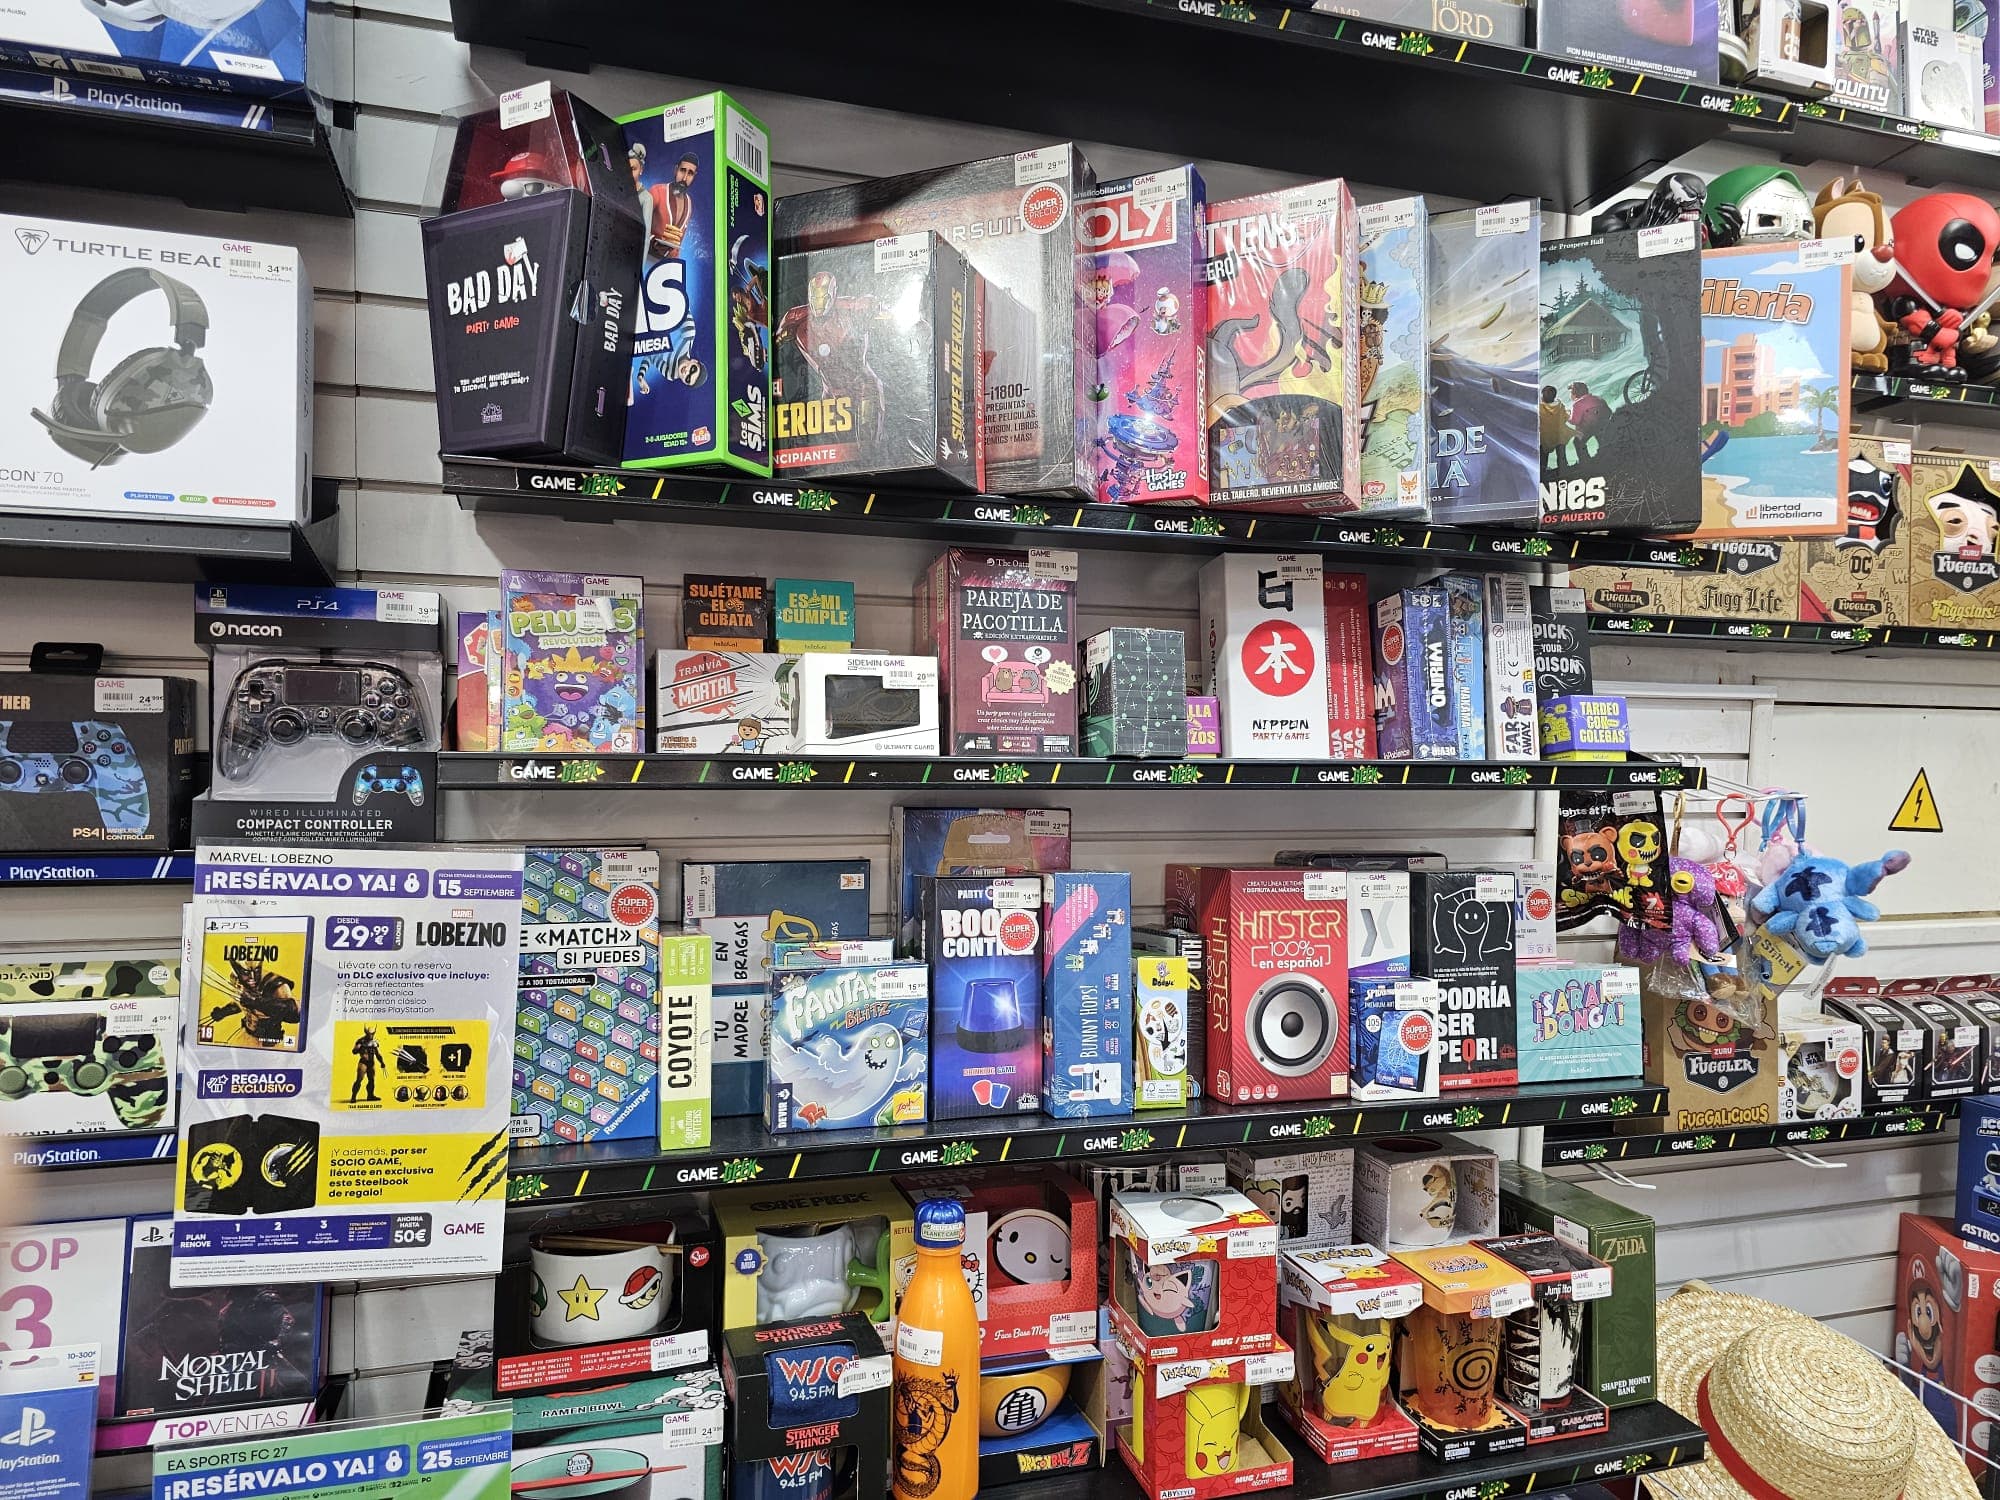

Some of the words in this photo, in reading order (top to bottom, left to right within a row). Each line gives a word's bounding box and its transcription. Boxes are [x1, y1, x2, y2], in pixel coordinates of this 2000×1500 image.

[1912, 27, 1937, 39] STAR
[1361, 32, 1397, 50] GAME
[1913, 35, 1939, 47] WARS
[1548, 67, 1579, 84] GAME
[87, 87, 182, 114] PlayStation
[1701, 95, 1731, 111] GAME
[1029, 197, 1057, 211] SÚPER
[1029, 205, 1059, 218] PRECIO
[53, 238, 152, 261] TURTLE
[222, 243, 252, 253] GAME
[447, 271, 491, 316] BAD
[498, 263, 540, 302] DAY
[608, 287, 624, 315] DAY
[466, 320, 490, 334] PARTY
[603, 316, 618, 353] BAD
[634, 337, 670, 354] MESA
[1436, 425, 1487, 458] DE
[44, 471, 63, 484] 70
[1146, 468, 1187, 482] Hasbro
[531, 476, 576, 491] GAME
[1148, 479, 1185, 491] GAMES
[1222, 490, 1229, 500] EL
[1262, 485, 1291, 497] REVIENTA
[1293, 485, 1298, 494] A
[1300, 483, 1311, 494] TUS
[1313, 480, 1340, 492] AMIGOS.
[1759, 503, 1800, 512] libertad
[1562, 511, 1605, 521] MUERTO
[1759, 511, 1822, 520] inmobiliaria
[1154, 520, 1188, 532] GAME
[1492, 541, 1521, 552] GAME
[1937, 555, 1997, 577] FUGGLER
[689, 583, 762, 599] SUJÉTAME
[297, 599, 338, 611] PS4
[712, 600, 725, 611] EL
[966, 589, 1033, 613] PAREJA
[1036, 593, 1063, 610] DE
[699, 613, 753, 627] CUBATA
[782, 607, 848, 625] CUMPLE
[962, 613, 1066, 633] PACOTILLA
[228, 622, 282, 637] nacon
[541, 636, 603, 646] REVOLUTION
[848, 659, 881, 667] SIDEWIN
[1254, 631, 1306, 683] 本
[678, 659, 722, 677] TRANVÍA
[96, 680, 125, 689] GAME
[678, 682, 734, 706] MORTAL
[1579, 701, 1619, 715] TARDEO
[1252, 719, 1309, 730] NIPPON
[1252, 731, 1283, 740] PARTY
[1285, 732, 1310, 740] GAME
[1504, 721, 1520, 754] FAR
[1523, 722, 1533, 755] AWAY
[1579, 730, 1625, 743] COLEGAS
[510, 766, 555, 779] GAME
[953, 768, 990, 781] GAME
[1317, 770, 1350, 782] GAME
[249, 809, 279, 817] WIRED
[287, 809, 381, 817] ILLUMINATED
[236, 818, 301, 829] COMPACT
[305, 819, 393, 830] CONTROLLER
[73, 827, 99, 838] PS4
[209, 851, 268, 864] MARVEL:
[271, 853, 333, 865] LOBEZNO
[204, 868, 353, 893] ¡RESÉRVALO
[359, 874, 396, 892] YA!
[439, 879, 461, 896] 15
[464, 888, 515, 897] SEPTIEMBRE
[617, 897, 648, 908] SÚPER
[452, 909, 473, 918] MARVEL
[616, 905, 648, 915] PRECIO
[1240, 910, 1341, 940] HITSTER
[416, 922, 506, 947] LOBEZNO
[535, 927, 632, 947] «MATCH»
[223, 945, 279, 962] LOBEZNO
[734, 921, 749, 980] BRAGAS
[1269, 942, 1315, 957] 100%
[563, 952, 577, 965] SI
[583, 950, 640, 964] PUEDES
[1259, 960, 1274, 969] en
[1276, 957, 1324, 971] español
[338, 961, 378, 970] Llévate
[353, 971, 374, 980] DLC
[376, 971, 425, 980] exclusivo
[428, 973, 446, 982] que
[449, 971, 490, 982] incluye:
[1080, 984, 1098, 1018] HOPS!
[1438, 982, 1511, 1010] PODRÍA
[734, 1000, 749, 1058] MADRE
[1439, 1013, 1475, 1036] SER
[200, 1027, 213, 1038] 18
[1080, 1019, 1098, 1058] BUNNY
[668, 994, 693, 1089] COYOTE
[1439, 1037, 1498, 1062] PEOR!
[1689, 1058, 1755, 1076] FUGGLER
[231, 1074, 286, 1086] REGALO
[231, 1082, 295, 1095] EXCLUSIVO
[603, 1087, 651, 1136] Ravensburger
[777, 1103, 787, 1129] DEVIR
[1678, 1104, 1769, 1131] FUGGALICIOUS
[1423, 1114, 1453, 1126] GAME
[14, 1148, 100, 1167] PlayStation
[391, 1148, 407, 1156] por
[331, 1158, 365, 1167] SOCIO
[368, 1158, 402, 1166] GAME,
[329, 1167, 366, 1177] llévate
[384, 1166, 433, 1175] exclusiva
[677, 1167, 718, 1181] GAME
[355, 1177, 409, 1186] Steelbook
[328, 1189, 341, 1197] de
[344, 1188, 383, 1199] regalo!
[394, 1229, 427, 1244] 50€
[443, 1223, 485, 1236] GAME
[180, 1240, 211, 1249] RENOVE
[185, 1233, 207, 1242] PLAN
[1152, 1240, 1191, 1254] Pokémon
[1602, 1238, 1647, 1262] ZELDA
[1211, 1337, 1230, 1346] MUG
[1241, 1335, 1272, 1344] TASSE
[159, 1350, 270, 1381] MORTAL
[175, 1374, 258, 1401] SHELL
[1601, 1380, 1625, 1391] SHAPED
[1628, 1376, 1651, 1386] MONEY
[1617, 1386, 1636, 1395] BANK
[789, 1388, 817, 1401] 94.5
[819, 1385, 835, 1397] FM
[541, 1405, 586, 1417] RAMEN
[590, 1403, 622, 1413] BOWL
[786, 1424, 839, 1442] STRANGER
[794, 1435, 834, 1448] THINGS
[167, 1460, 186, 1472] EA
[189, 1451, 247, 1468] SPORTS
[250, 1450, 269, 1462] FC
[273, 1447, 287, 1458] 27
[423, 1451, 452, 1470] 25
[455, 1450, 509, 1466] SEPTIEMBRE
[1594, 1460, 1622, 1474] GAME
[164, 1462, 328, 1500] ¡RESÉRVALO
[335, 1454, 375, 1476] YA!
